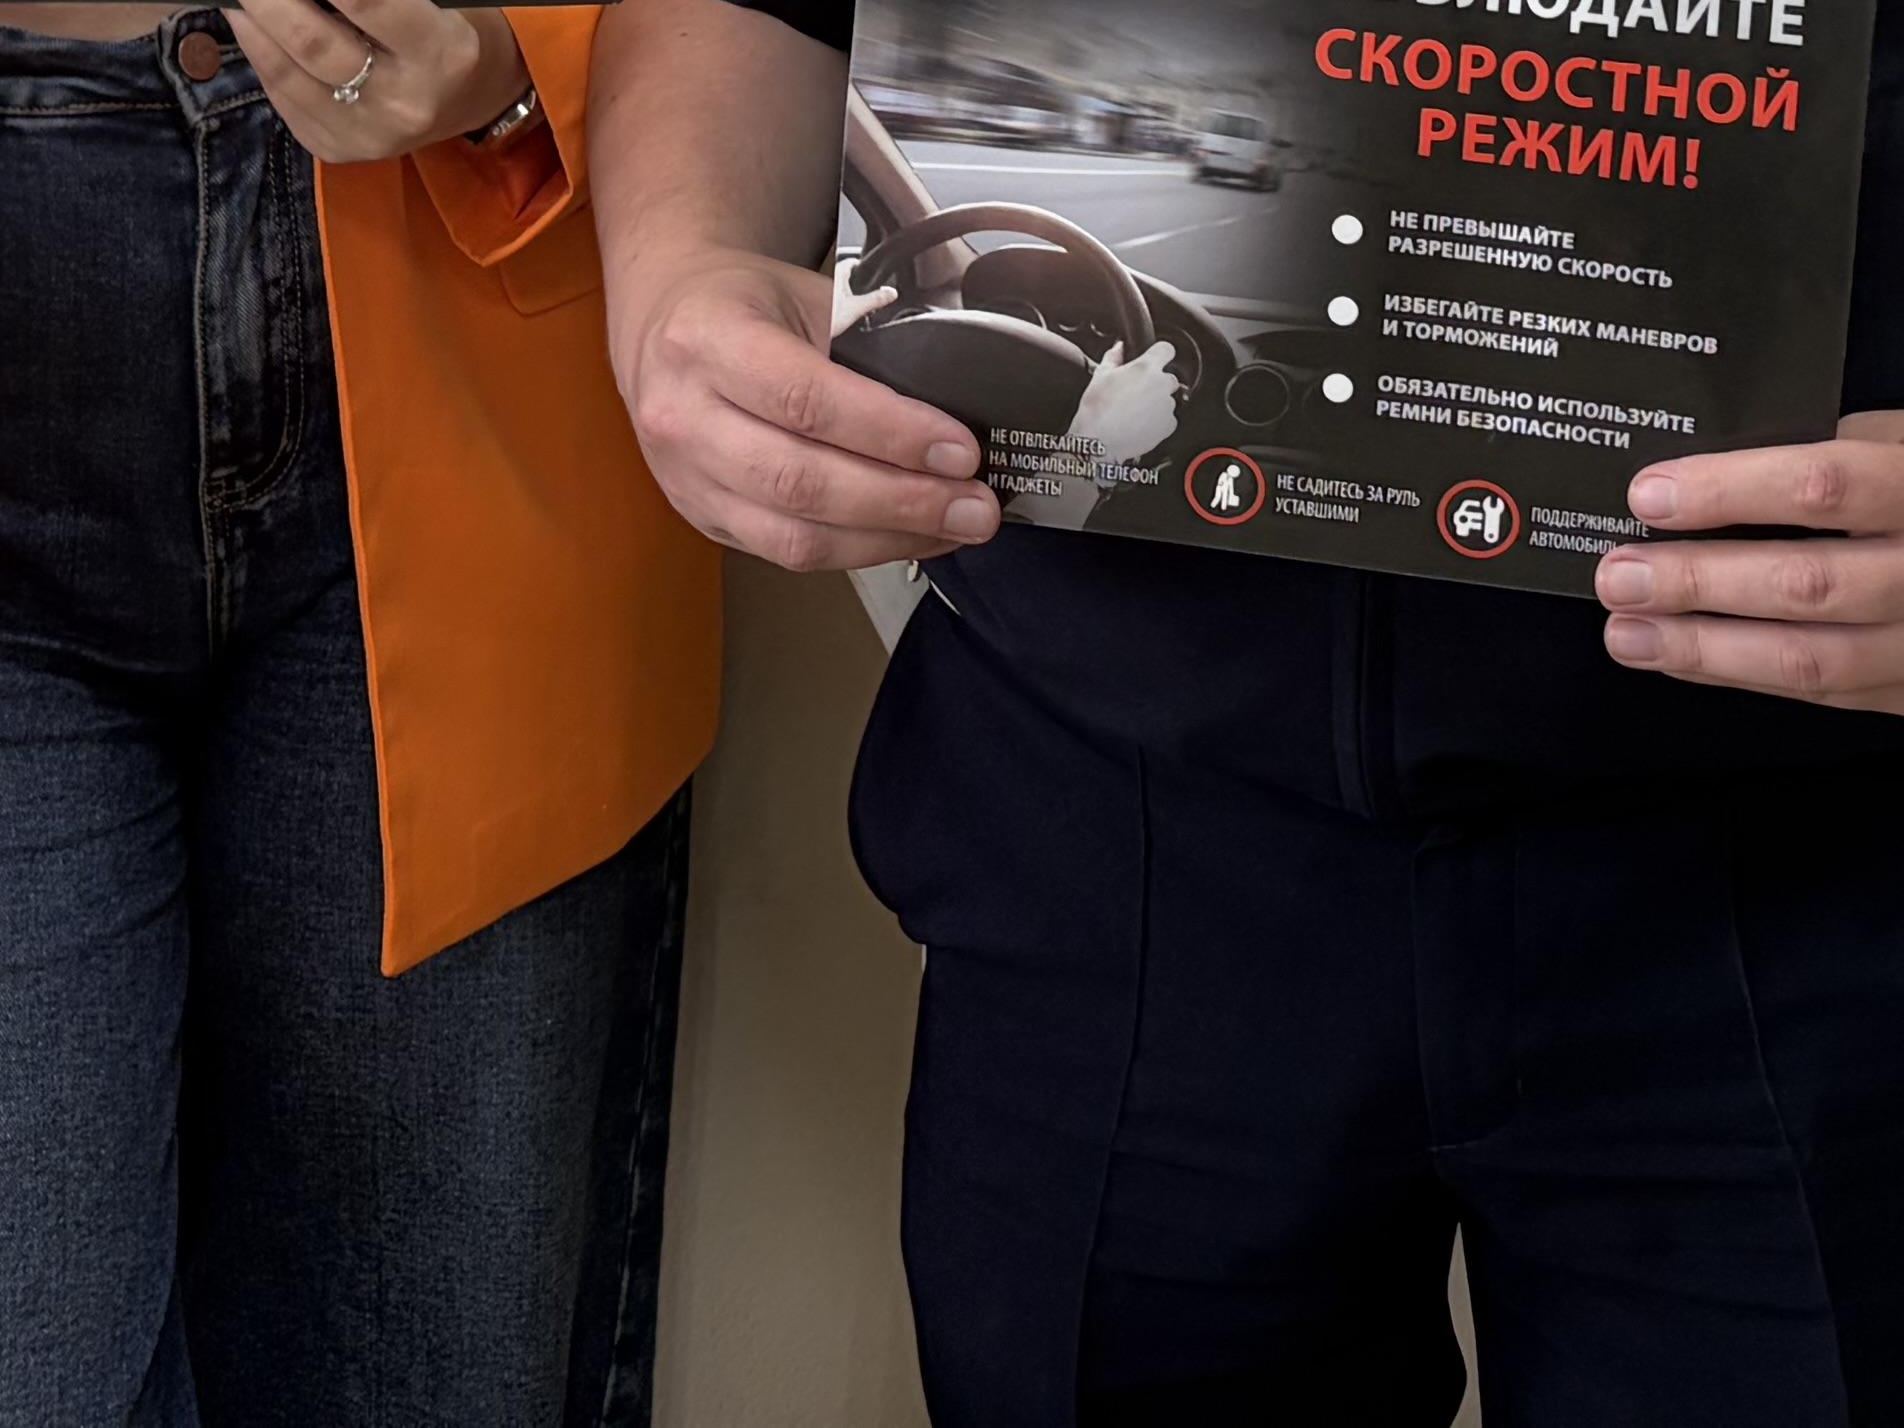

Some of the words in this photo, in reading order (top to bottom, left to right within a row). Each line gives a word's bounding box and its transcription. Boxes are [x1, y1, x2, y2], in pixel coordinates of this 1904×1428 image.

[1314, 27, 1801, 131] СКОРОСТНОЙ
[1416, 106, 1702, 190] РЕЖИМ!
[1389, 209, 1419, 230] НЕ
[1423, 214, 1575, 250] ПРЕВЫШАЙТЕ
[1388, 235, 1553, 272] РАЗРЕШЕННУЮ
[1557, 257, 1673, 289] СКОРОСТЬ
[1382, 318, 1399, 337] И
[1403, 320, 1559, 358] ТОРМОЖЕНИЙ
[1384, 294, 1504, 328] ИЗБЕГАЙТЕ
[1508, 309, 1592, 341] РЕЗКИХ
[1596, 322, 1718, 355] МАНЕВРОВ
[1375, 399, 1452, 425] РЕМНИ
[1456, 409, 1630, 449] БЕЗОПАСНОСТИ
[1377, 375, 1534, 419] ОБЯЗАТЕЛЬНО
[1537, 395, 1695, 434] ИСПОЛЬЗУЙТЕ
[990, 428, 1008, 445] НЕ
[1009, 431, 1106, 455] ОТВЛЕКАЙТЕСЬ
[989, 450, 1009, 467] НА
[1010, 452, 1096, 477] МОБИЛЬНЫЙ
[1099, 463, 1159, 486] ТЕЛЕФОН
[1000, 474, 1063, 496] ГАДЖЕТЫ
[1275, 496, 1360, 523] УСТАВШИМИ
[1277, 473, 1295, 492] НЕ
[1296, 476, 1365, 501] САДИТЕСЬ
[1366, 485, 1385, 503] ЗА
[1386, 488, 1421, 508] РУЛЬ
[1531, 506, 1649, 538] ПОДДЕРЖИВАЙТЕ
